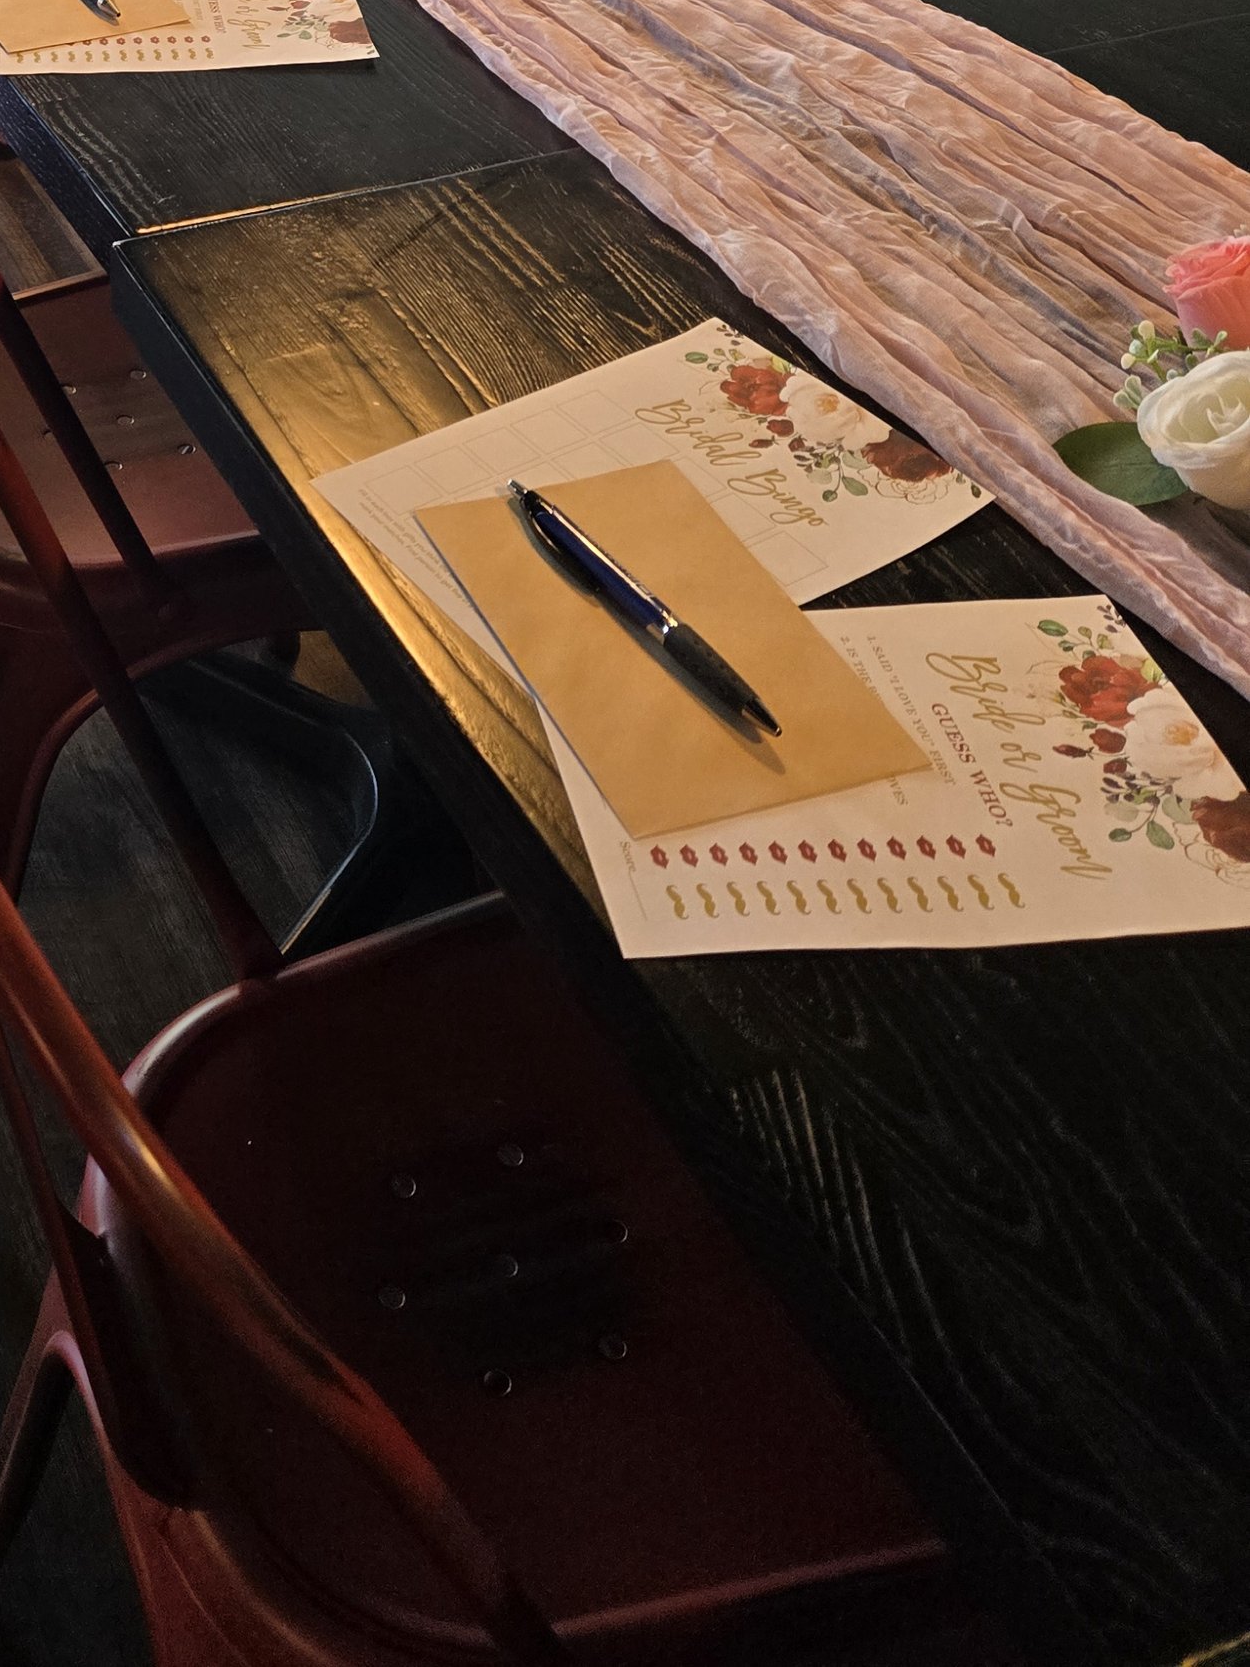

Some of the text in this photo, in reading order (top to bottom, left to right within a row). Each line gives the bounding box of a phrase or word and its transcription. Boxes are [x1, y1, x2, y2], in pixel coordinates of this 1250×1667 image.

[635, 399, 830, 527] Bridal Bingo
[846, 646, 859, 658] IS
[854, 660, 873, 684] THE
[872, 646, 894, 673] SAID
[893, 683, 917, 716] LOVE
[912, 718, 935, 746] YOU"
[929, 749, 957, 785] FIRST
[925, 652, 1113, 881] Bride or Groom
[931, 702, 1013, 828] GUESS WHO?
[619, 841, 636, 872] Score
